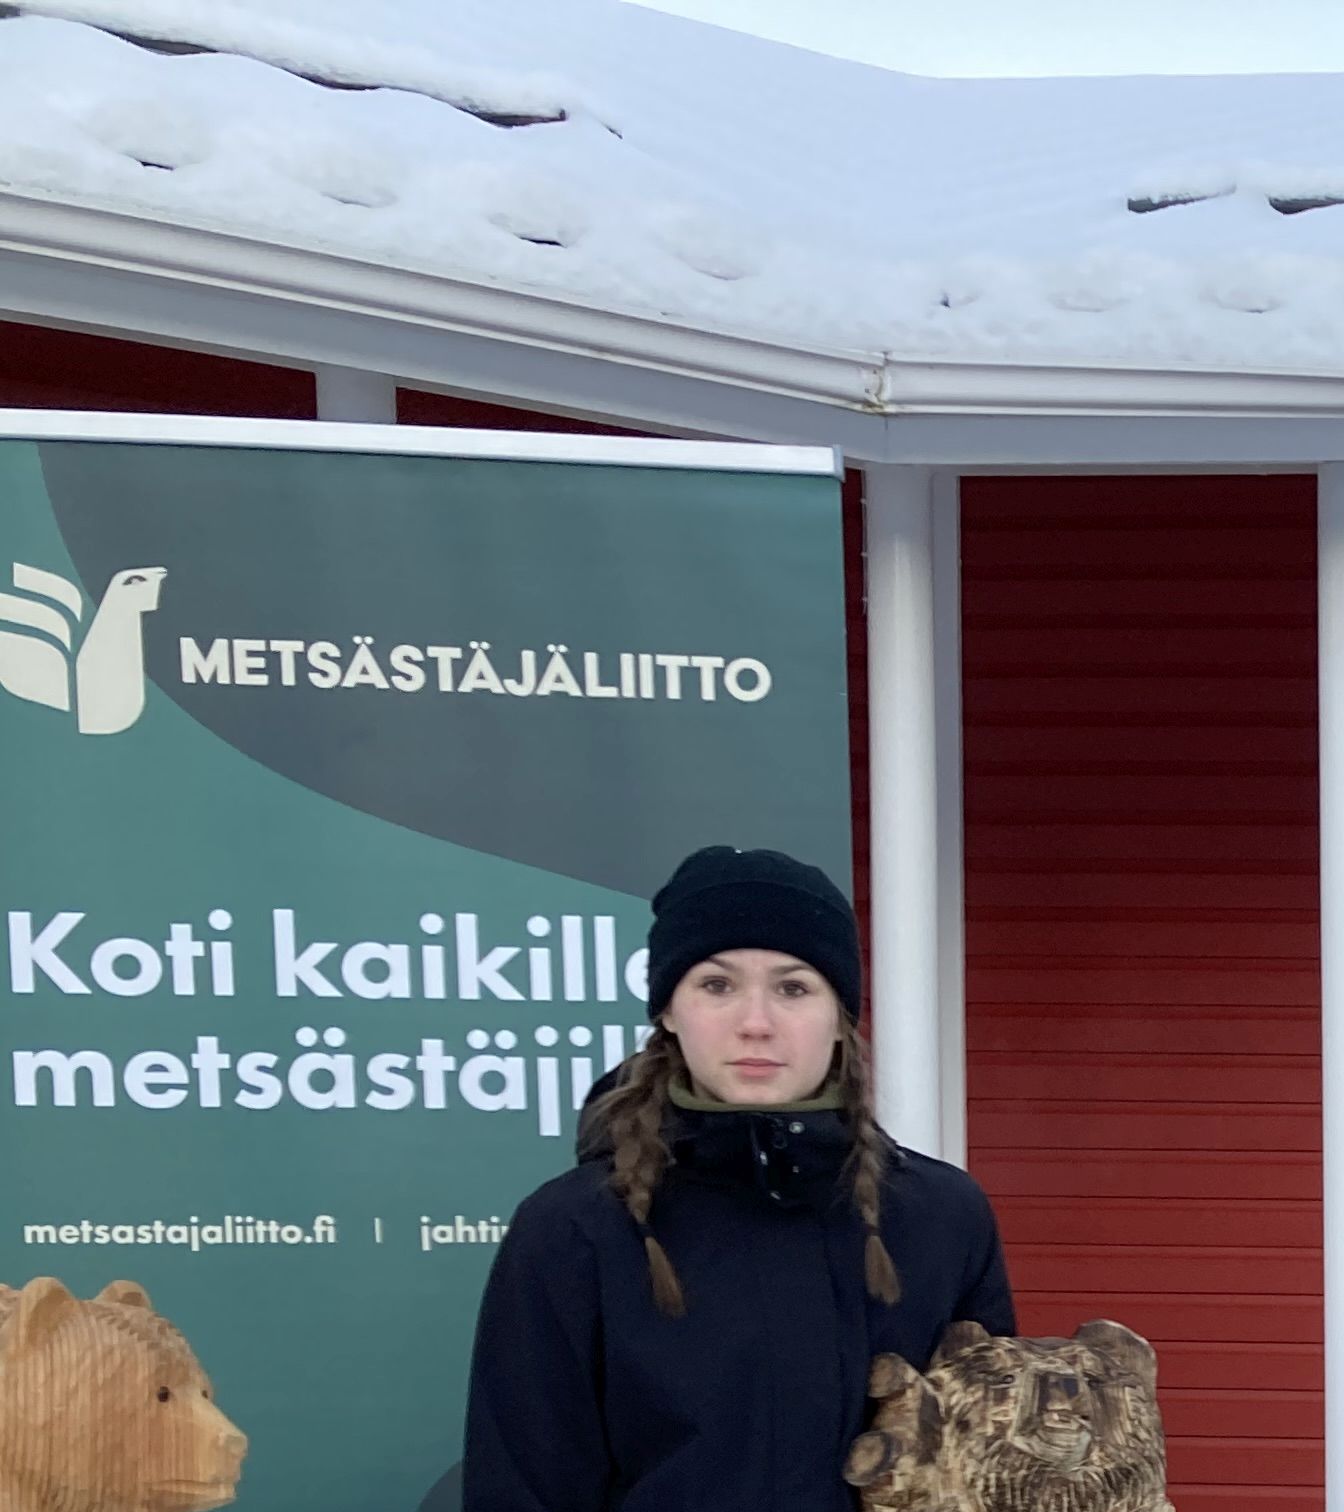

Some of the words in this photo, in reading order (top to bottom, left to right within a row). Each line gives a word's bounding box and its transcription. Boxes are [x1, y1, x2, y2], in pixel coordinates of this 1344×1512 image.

[180, 635, 772, 702] METSÄSTÄJÄLIITTO
[7, 908, 235, 998] Koti
[13, 1025, 655, 1137] metsästäjil
[23, 1215, 336, 1252] metsastajaliitto.fi
